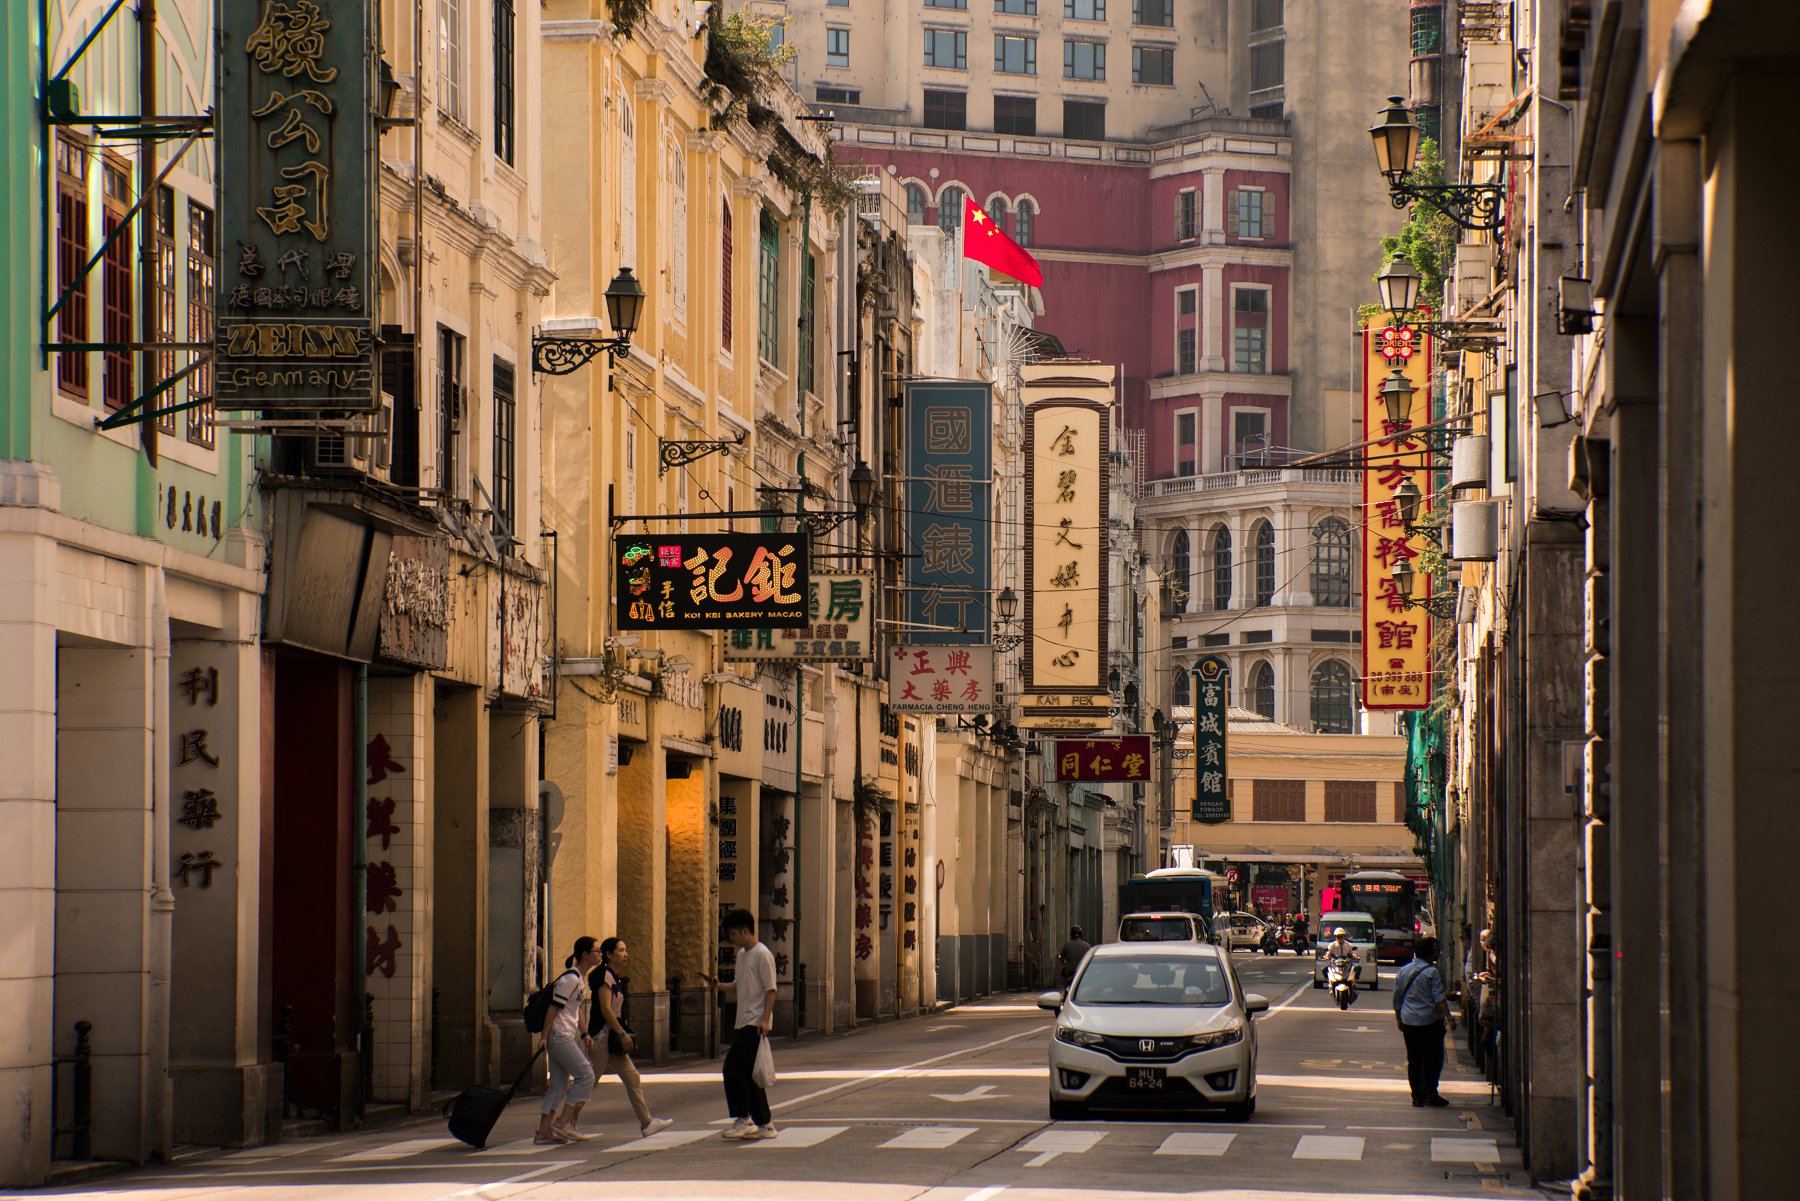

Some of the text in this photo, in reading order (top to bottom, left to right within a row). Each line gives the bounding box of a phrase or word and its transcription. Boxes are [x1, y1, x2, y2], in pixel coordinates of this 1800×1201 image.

[227, 324, 360, 358] ZEISS
[232, 368, 355, 389] Germany
[658, 580, 675, 619] 手信
[809, 579, 864, 622] 房
[725, 611, 764, 619] BAKERY
[910, 650, 972, 676] 正興
[900, 679, 982, 702] 大藥房
[1037, 695, 1093, 705] KAM PEK
[892, 703, 991, 711] FARMACIA CHENG HENG
[1200, 683, 1222, 793] 富城賓館
[174, 666, 222, 889] 利民藥行
[1062, 752, 1145, 779] 同仁堂
[1129, 1079, 1163, 1088] 64-24
[1138, 1069, 1154, 1078] MU
